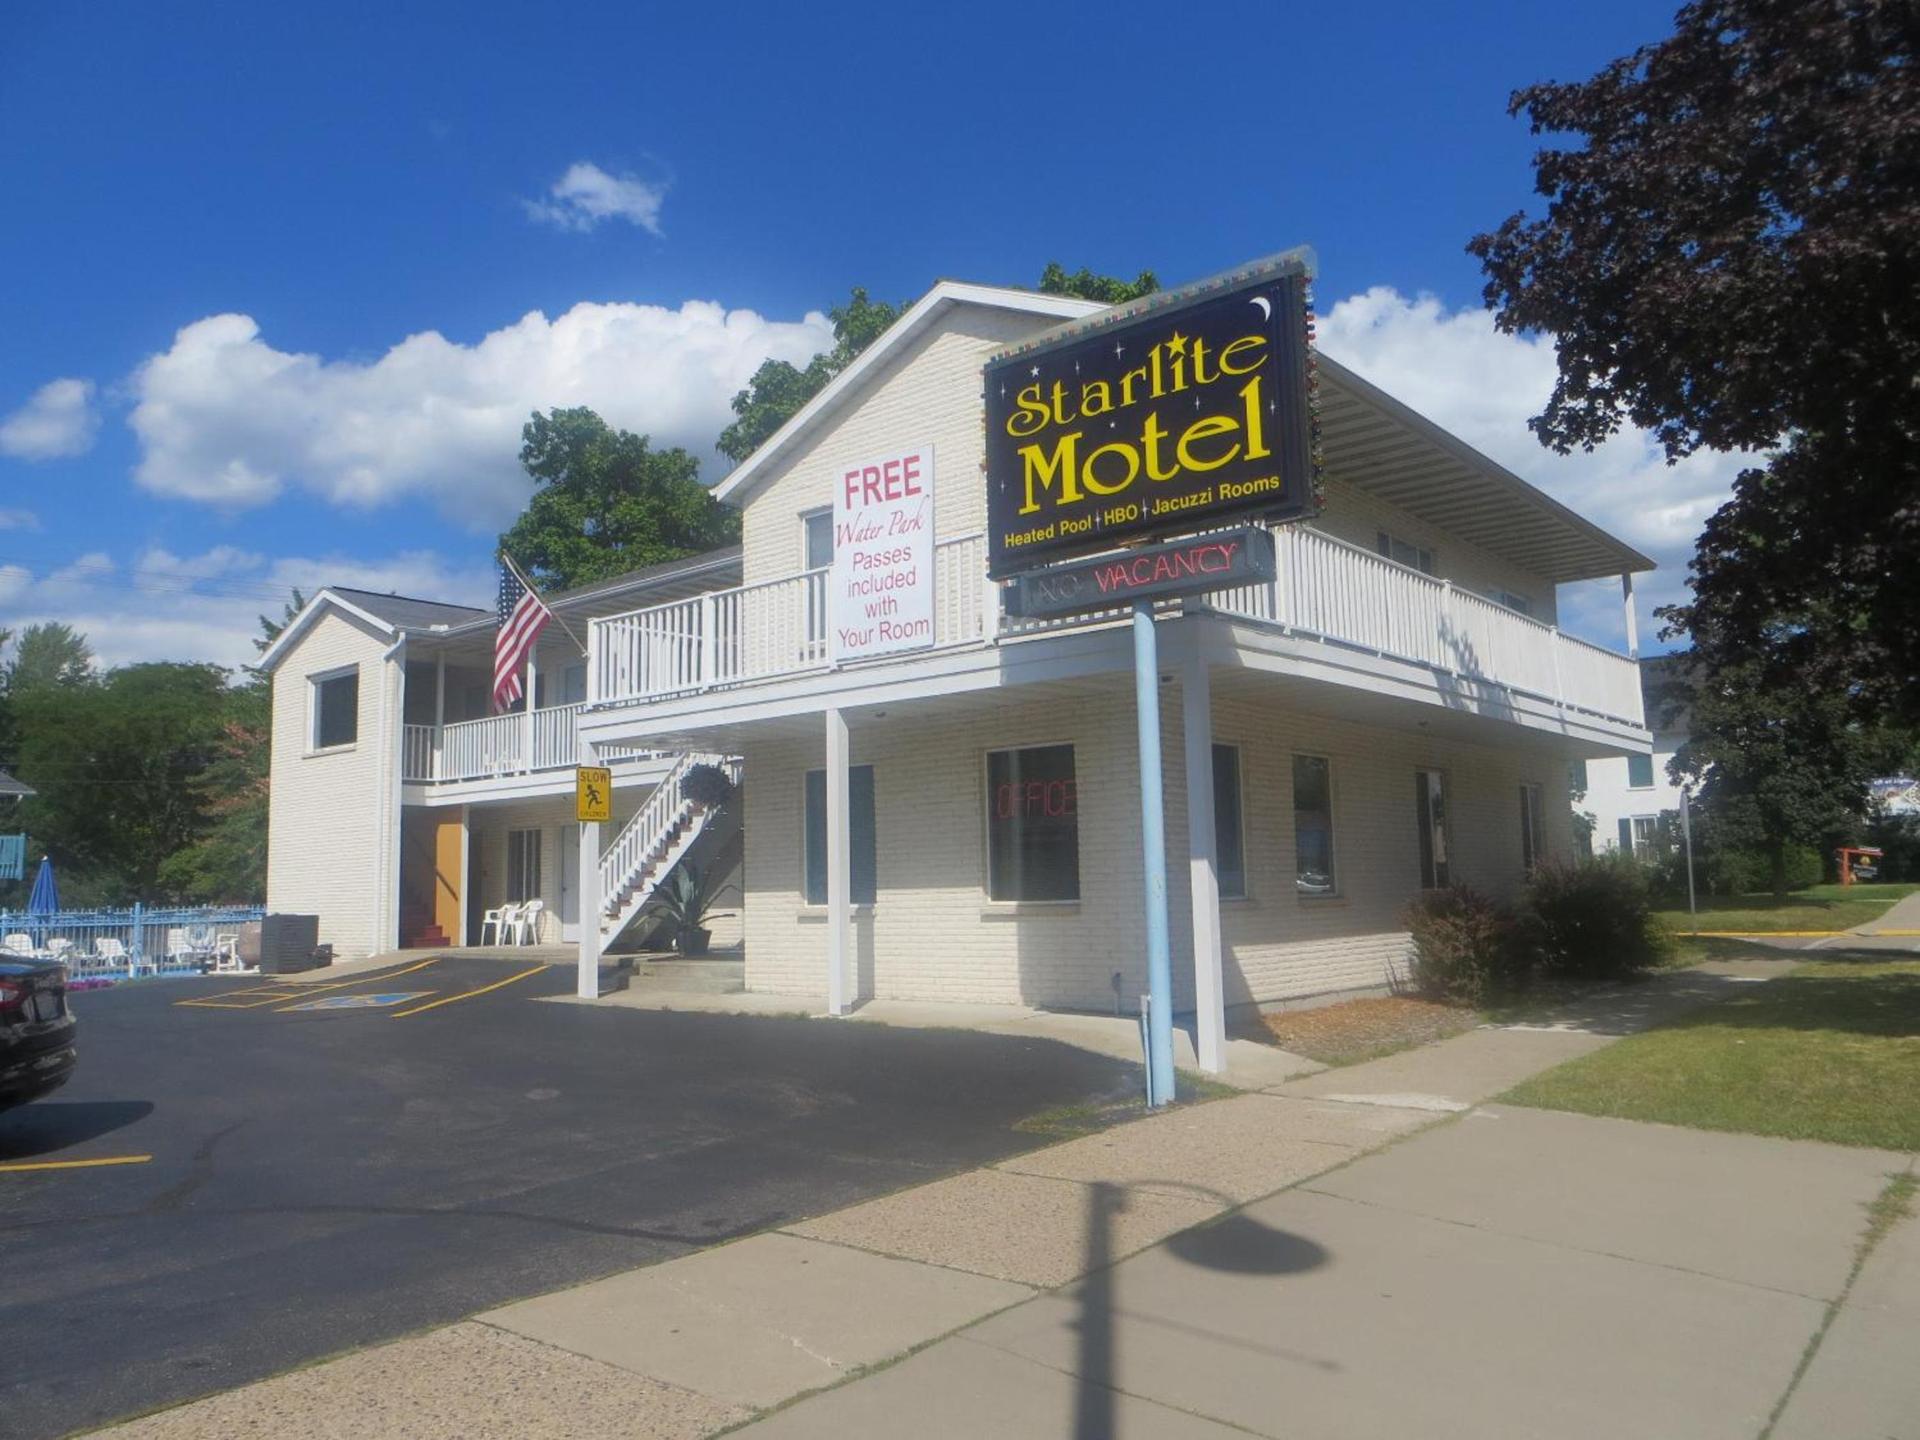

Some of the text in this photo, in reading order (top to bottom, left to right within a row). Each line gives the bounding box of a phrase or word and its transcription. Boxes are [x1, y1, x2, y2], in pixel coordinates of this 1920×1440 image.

[1006, 331, 1268, 437] Starlite
[1017, 375, 1271, 515] Motel
[845, 455, 921, 509] FREE
[836, 495, 930, 547] Water Park
[1005, 475, 1280, 548] Heated Pool HBO Jacuzzi Rooms
[848, 567, 916, 597] included
[853, 547, 912, 571] Passes
[1095, 543, 1239, 592] VACANCY
[865, 597, 898, 618] with
[838, 618, 929, 648] Your Room
[580, 771, 607, 783] SLOW
